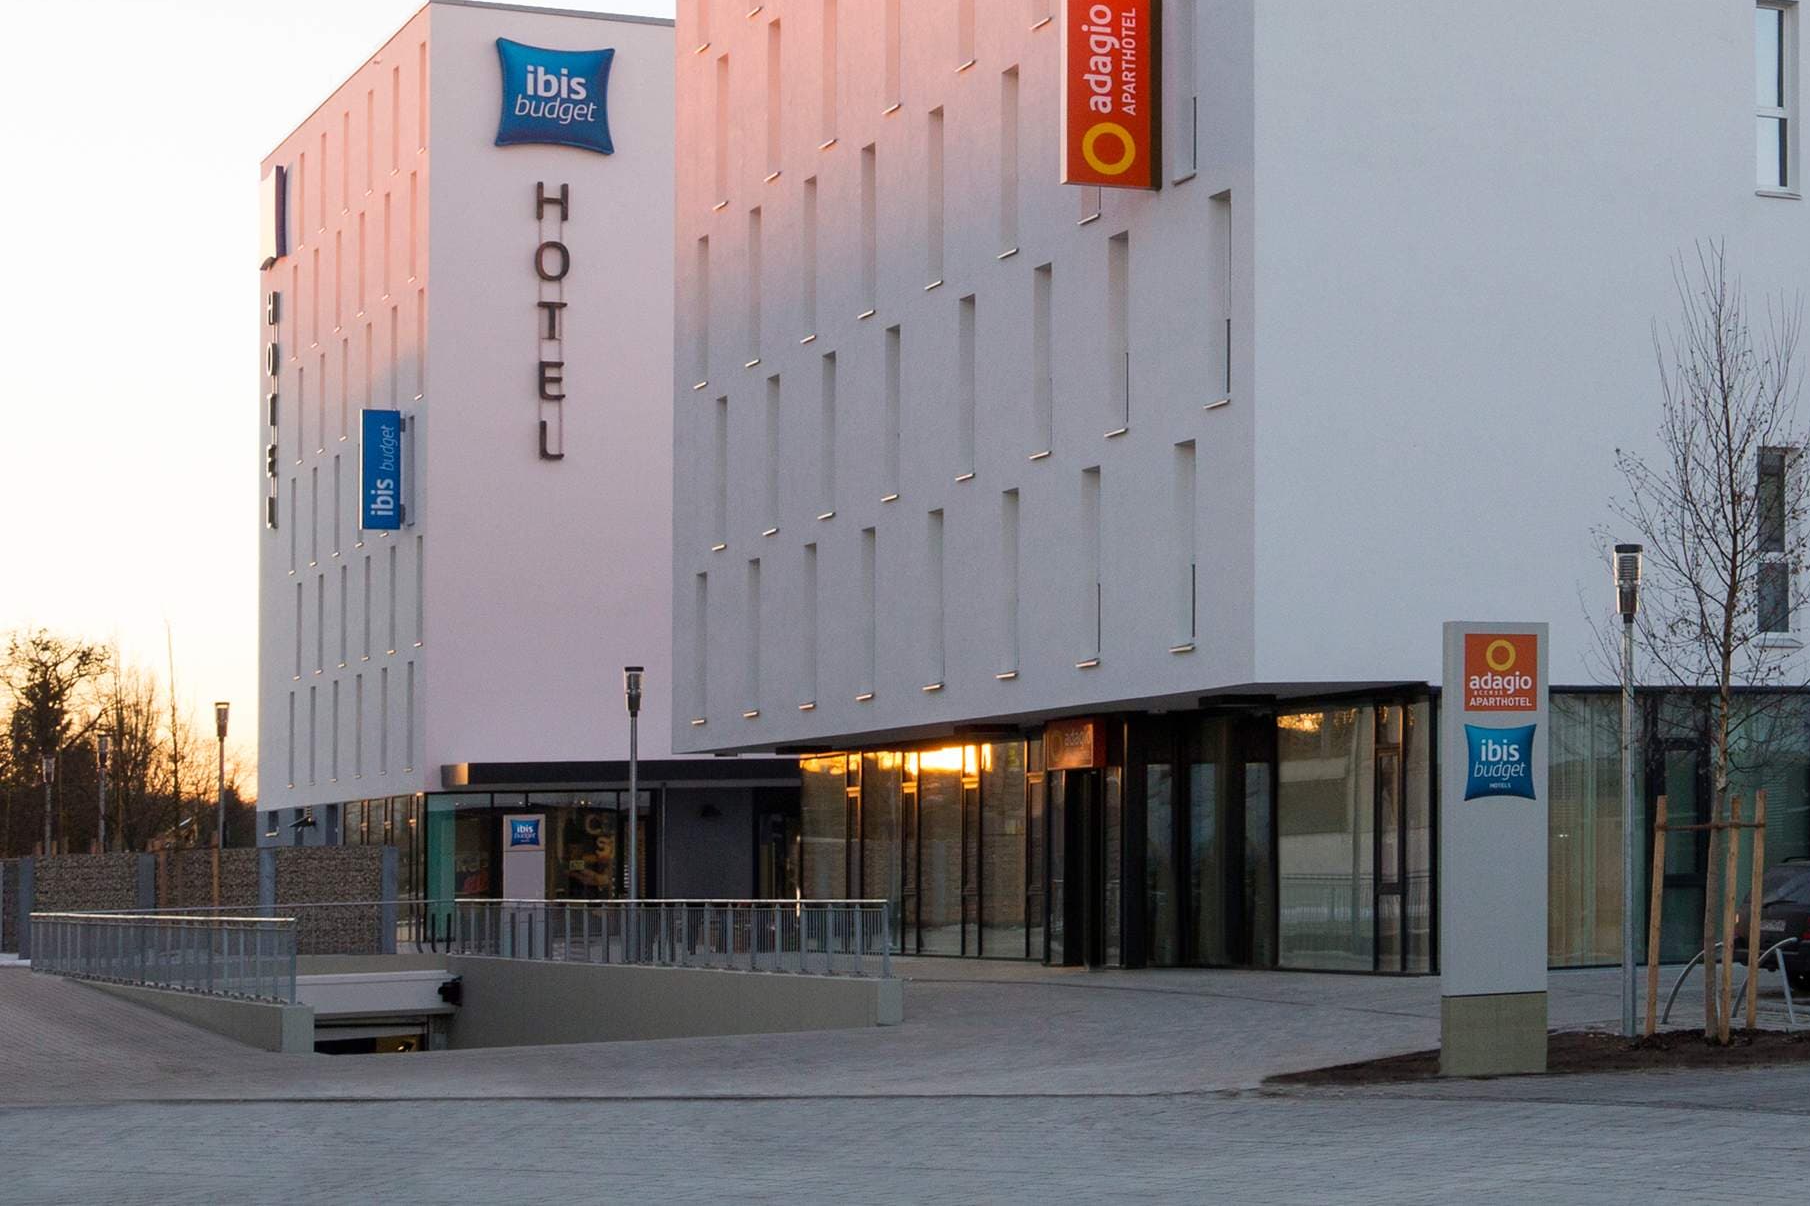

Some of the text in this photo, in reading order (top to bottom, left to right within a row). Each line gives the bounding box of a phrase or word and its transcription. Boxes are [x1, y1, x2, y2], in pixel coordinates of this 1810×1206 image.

[1081, 4, 1120, 114] adagio
[1121, 8, 1136, 116] APARTHOTEL
[526, 65, 587, 100] ibis
[515, 94, 598, 124] budget
[535, 180, 570, 461] HOTEL
[266, 291, 279, 529] HOTEL
[370, 425, 398, 516] ibis budget
[1469, 671, 1532, 694] adagio
[1469, 697, 1532, 706] APARTHOTEL
[1480, 739, 1520, 762] ibis
[1473, 761, 1526, 781] budget
